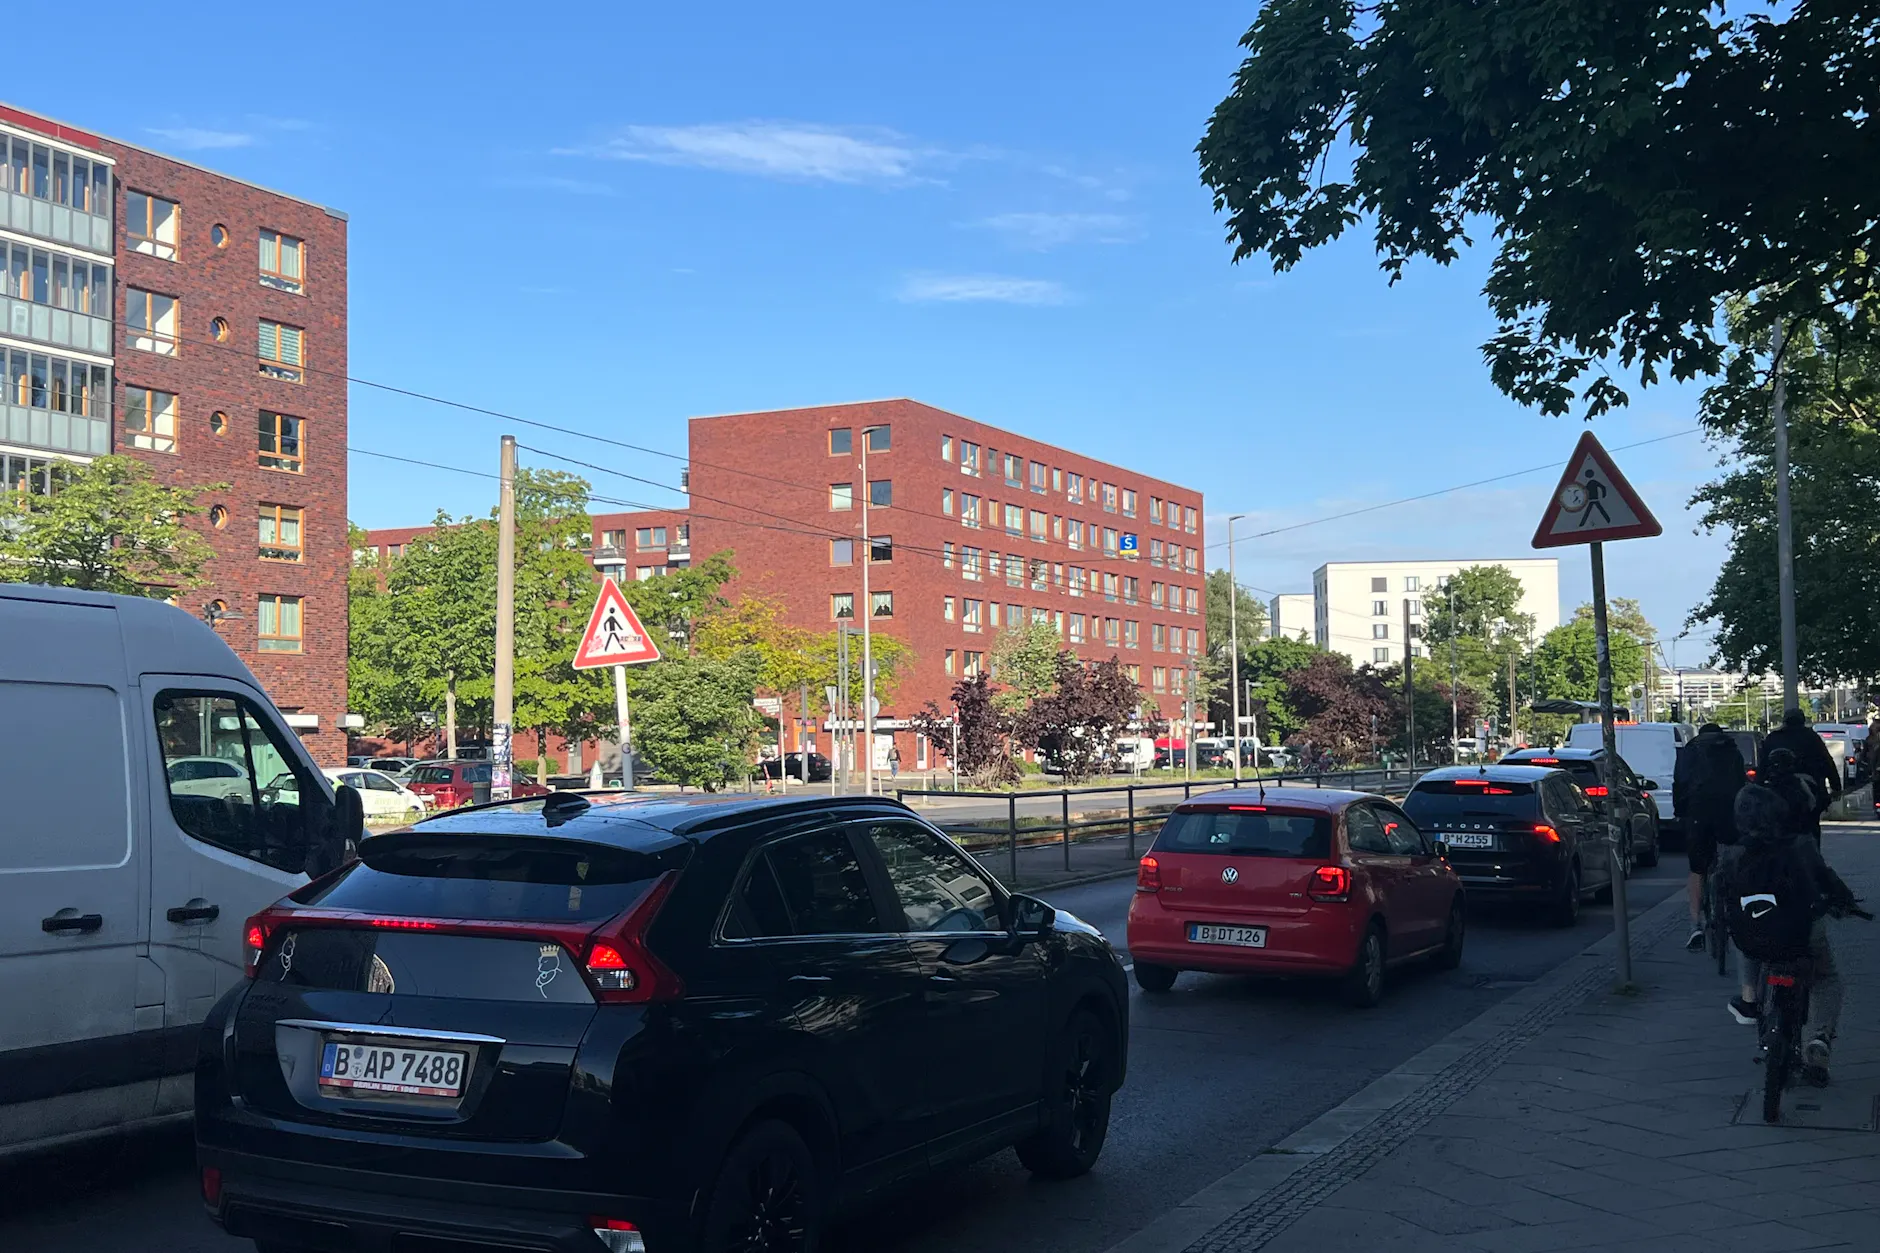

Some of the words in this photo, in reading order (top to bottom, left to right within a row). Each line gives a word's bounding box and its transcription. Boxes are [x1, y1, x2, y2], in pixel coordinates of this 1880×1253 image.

[1124, 537, 1133, 549] S
[1444, 834, 1450, 844] B
[1456, 834, 1463, 844] H
[1464, 835, 1488, 844] 2155
[1201, 927, 1210, 939] B
[1218, 929, 1234, 941] DT
[1236, 931, 1260, 943] 126
[334, 1047, 350, 1075] B
[363, 1050, 395, 1079] AP
[401, 1053, 460, 1086] 7488
[352, 1080, 380, 1090] BERLIN
